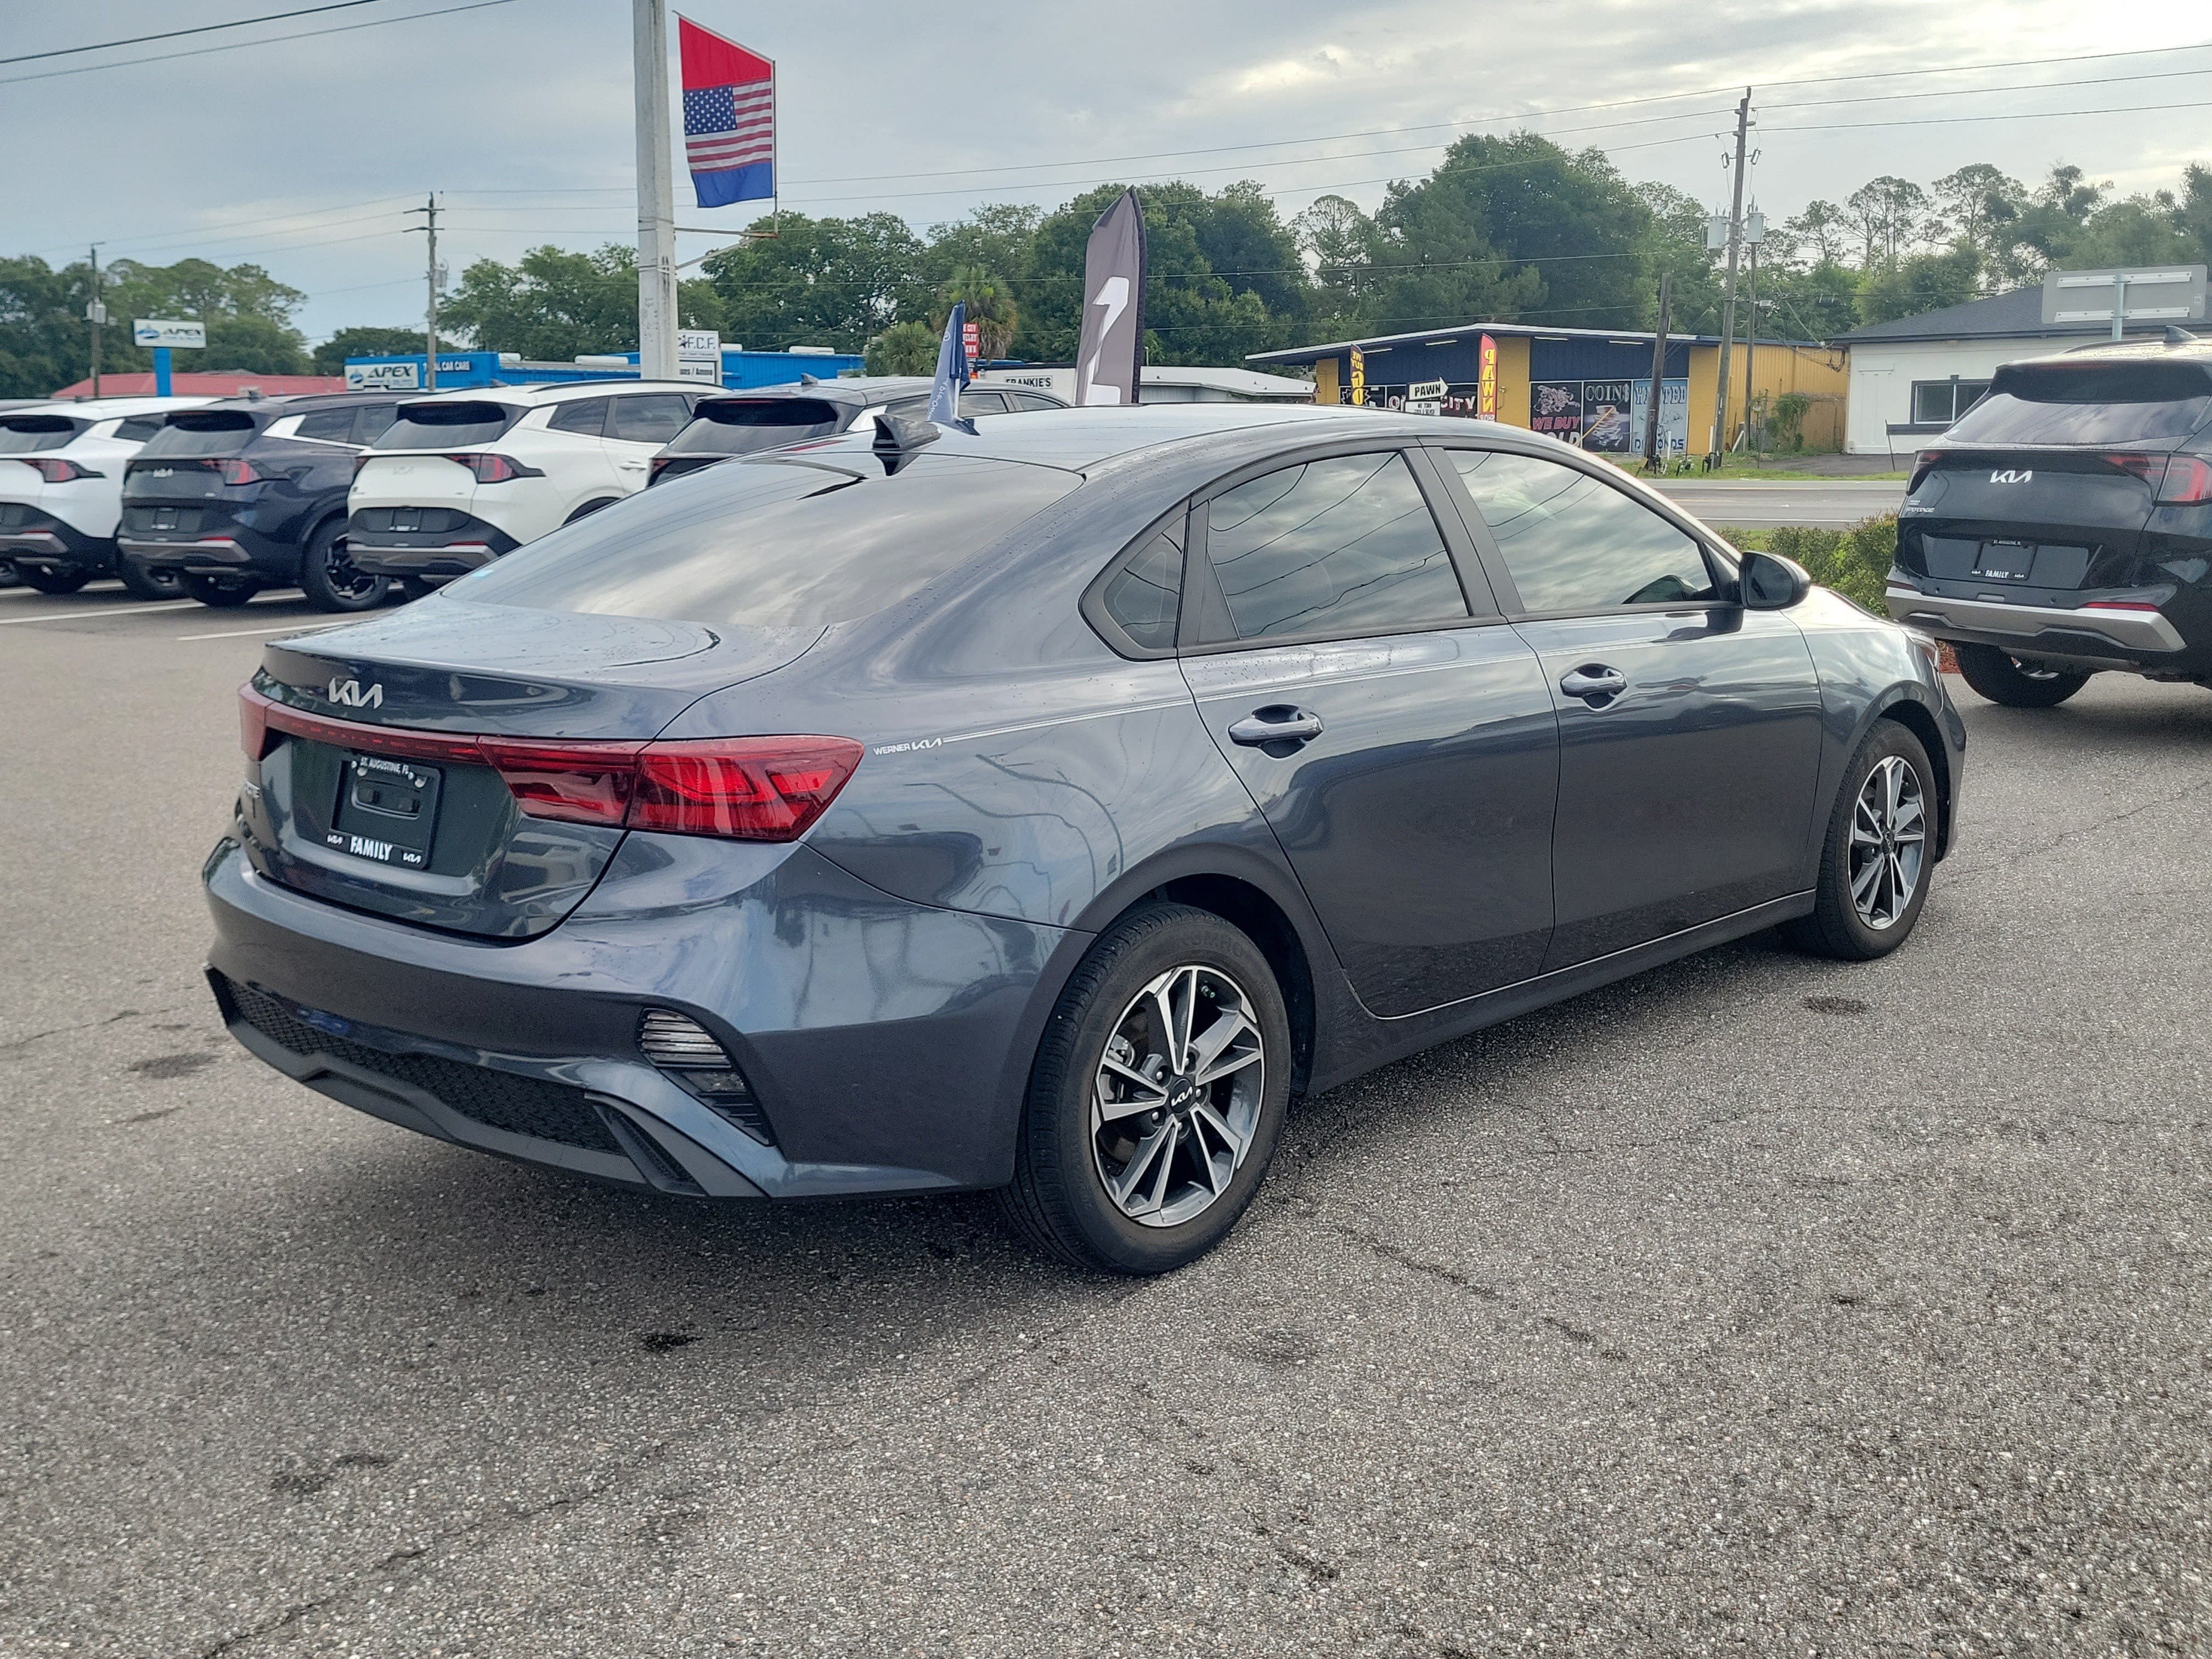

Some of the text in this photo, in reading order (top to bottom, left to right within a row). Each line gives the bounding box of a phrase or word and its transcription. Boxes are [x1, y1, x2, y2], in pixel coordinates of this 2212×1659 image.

[368, 365, 413, 377] APEX
[1414, 384, 1441, 397] PAWN
[1634, 386, 1686, 405] WTED
[1532, 416, 1581, 430] WE BUY
[1990, 470, 2033, 483] KIA
[1985, 570, 2009, 578] FAMILY
[329, 678, 383, 709] KIA
[873, 737, 943, 755] WERNER KIA
[350, 836, 393, 861] FAMILY
[1171, 1086, 1193, 1107] KIA
